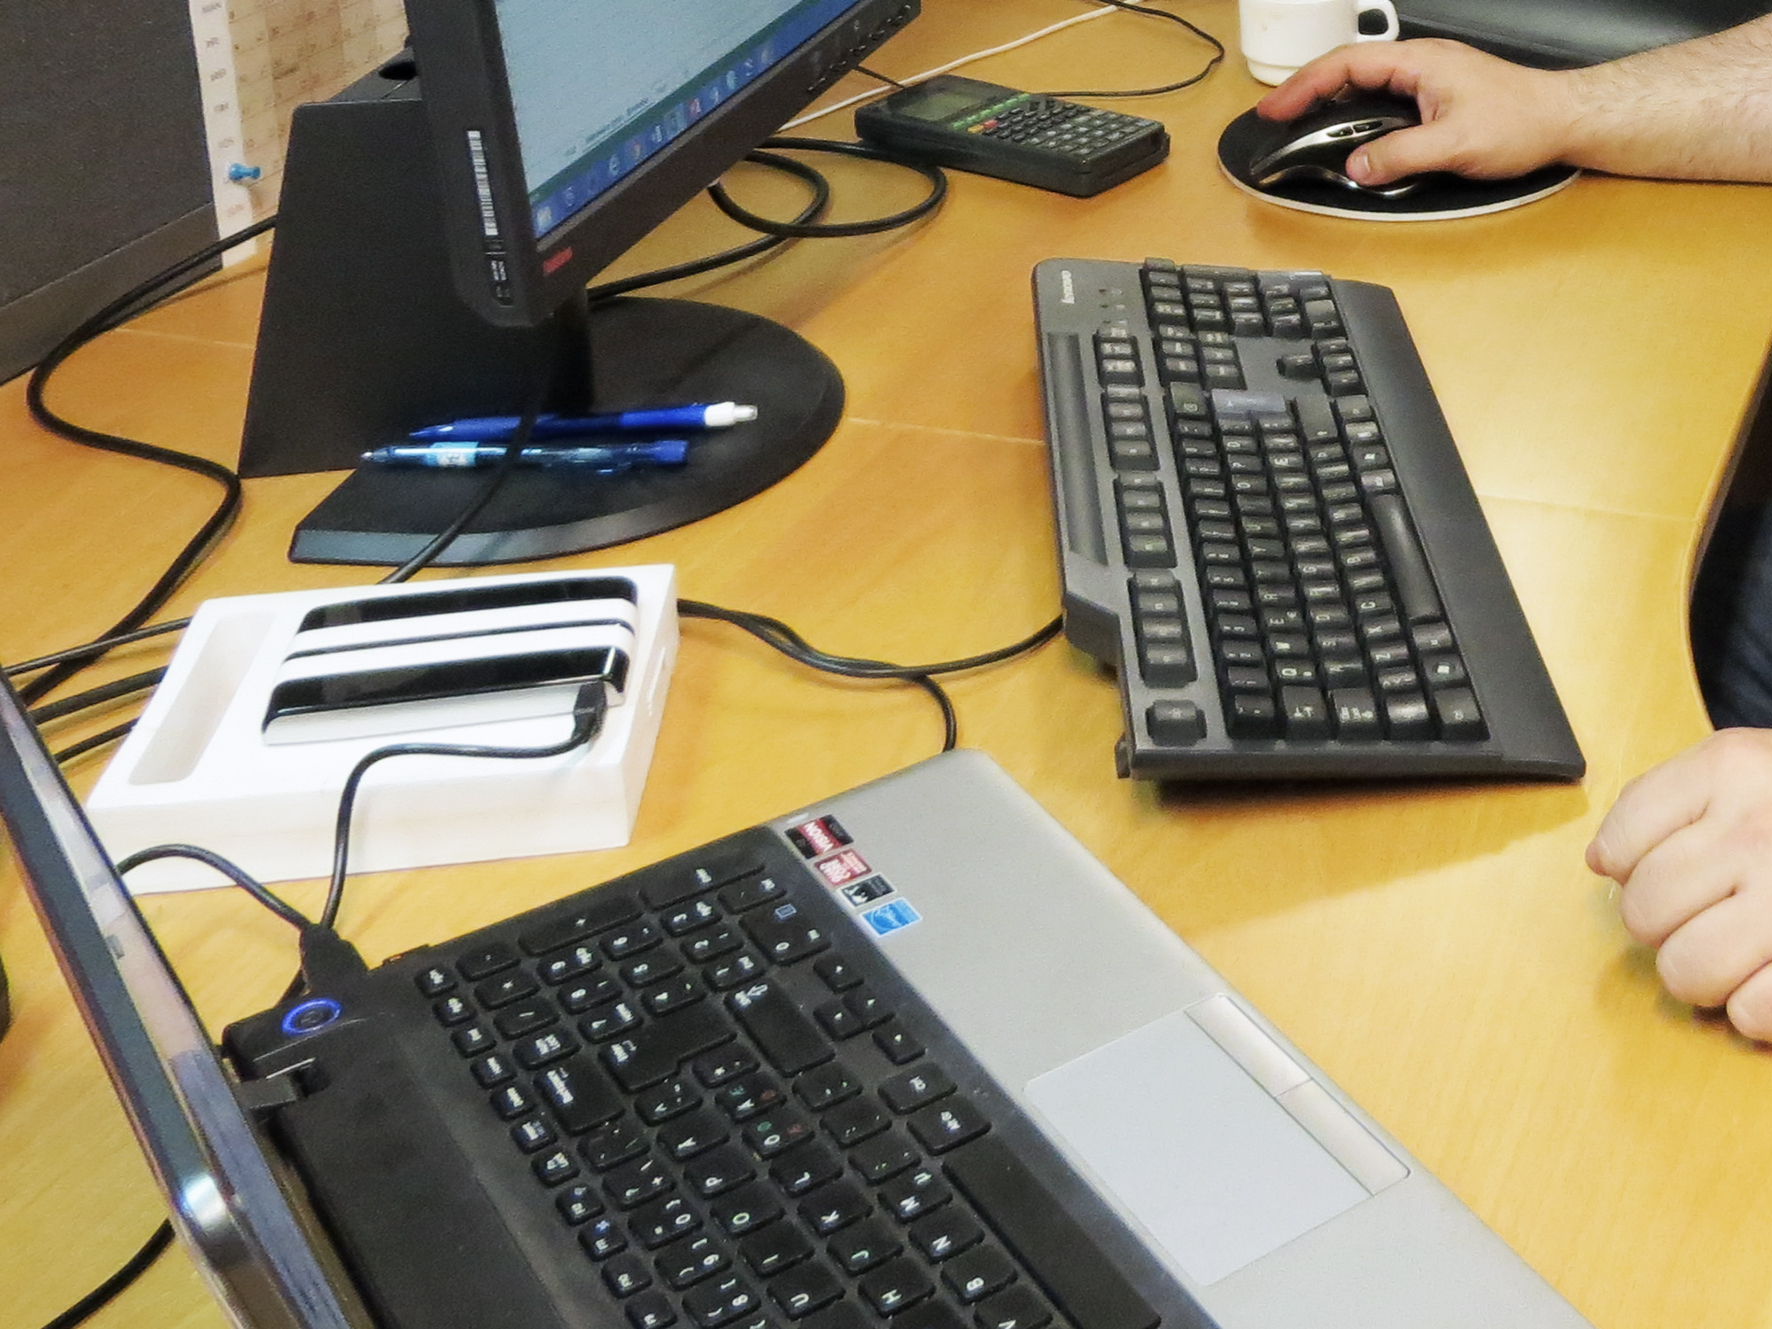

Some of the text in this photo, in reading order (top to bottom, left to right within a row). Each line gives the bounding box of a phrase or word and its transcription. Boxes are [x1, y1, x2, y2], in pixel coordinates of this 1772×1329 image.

[803, 821, 834, 852] VISION
[705, 1176, 723, 1187] P
[821, 1210, 840, 1223] K
[932, 1235, 951, 1251] N
[703, 1254, 719, 1266] 9
[851, 1249, 869, 1261] J
[966, 1277, 984, 1291] B
[732, 1294, 748, 1307] 8
[791, 1293, 810, 1307] U
[881, 1289, 902, 1305] H
